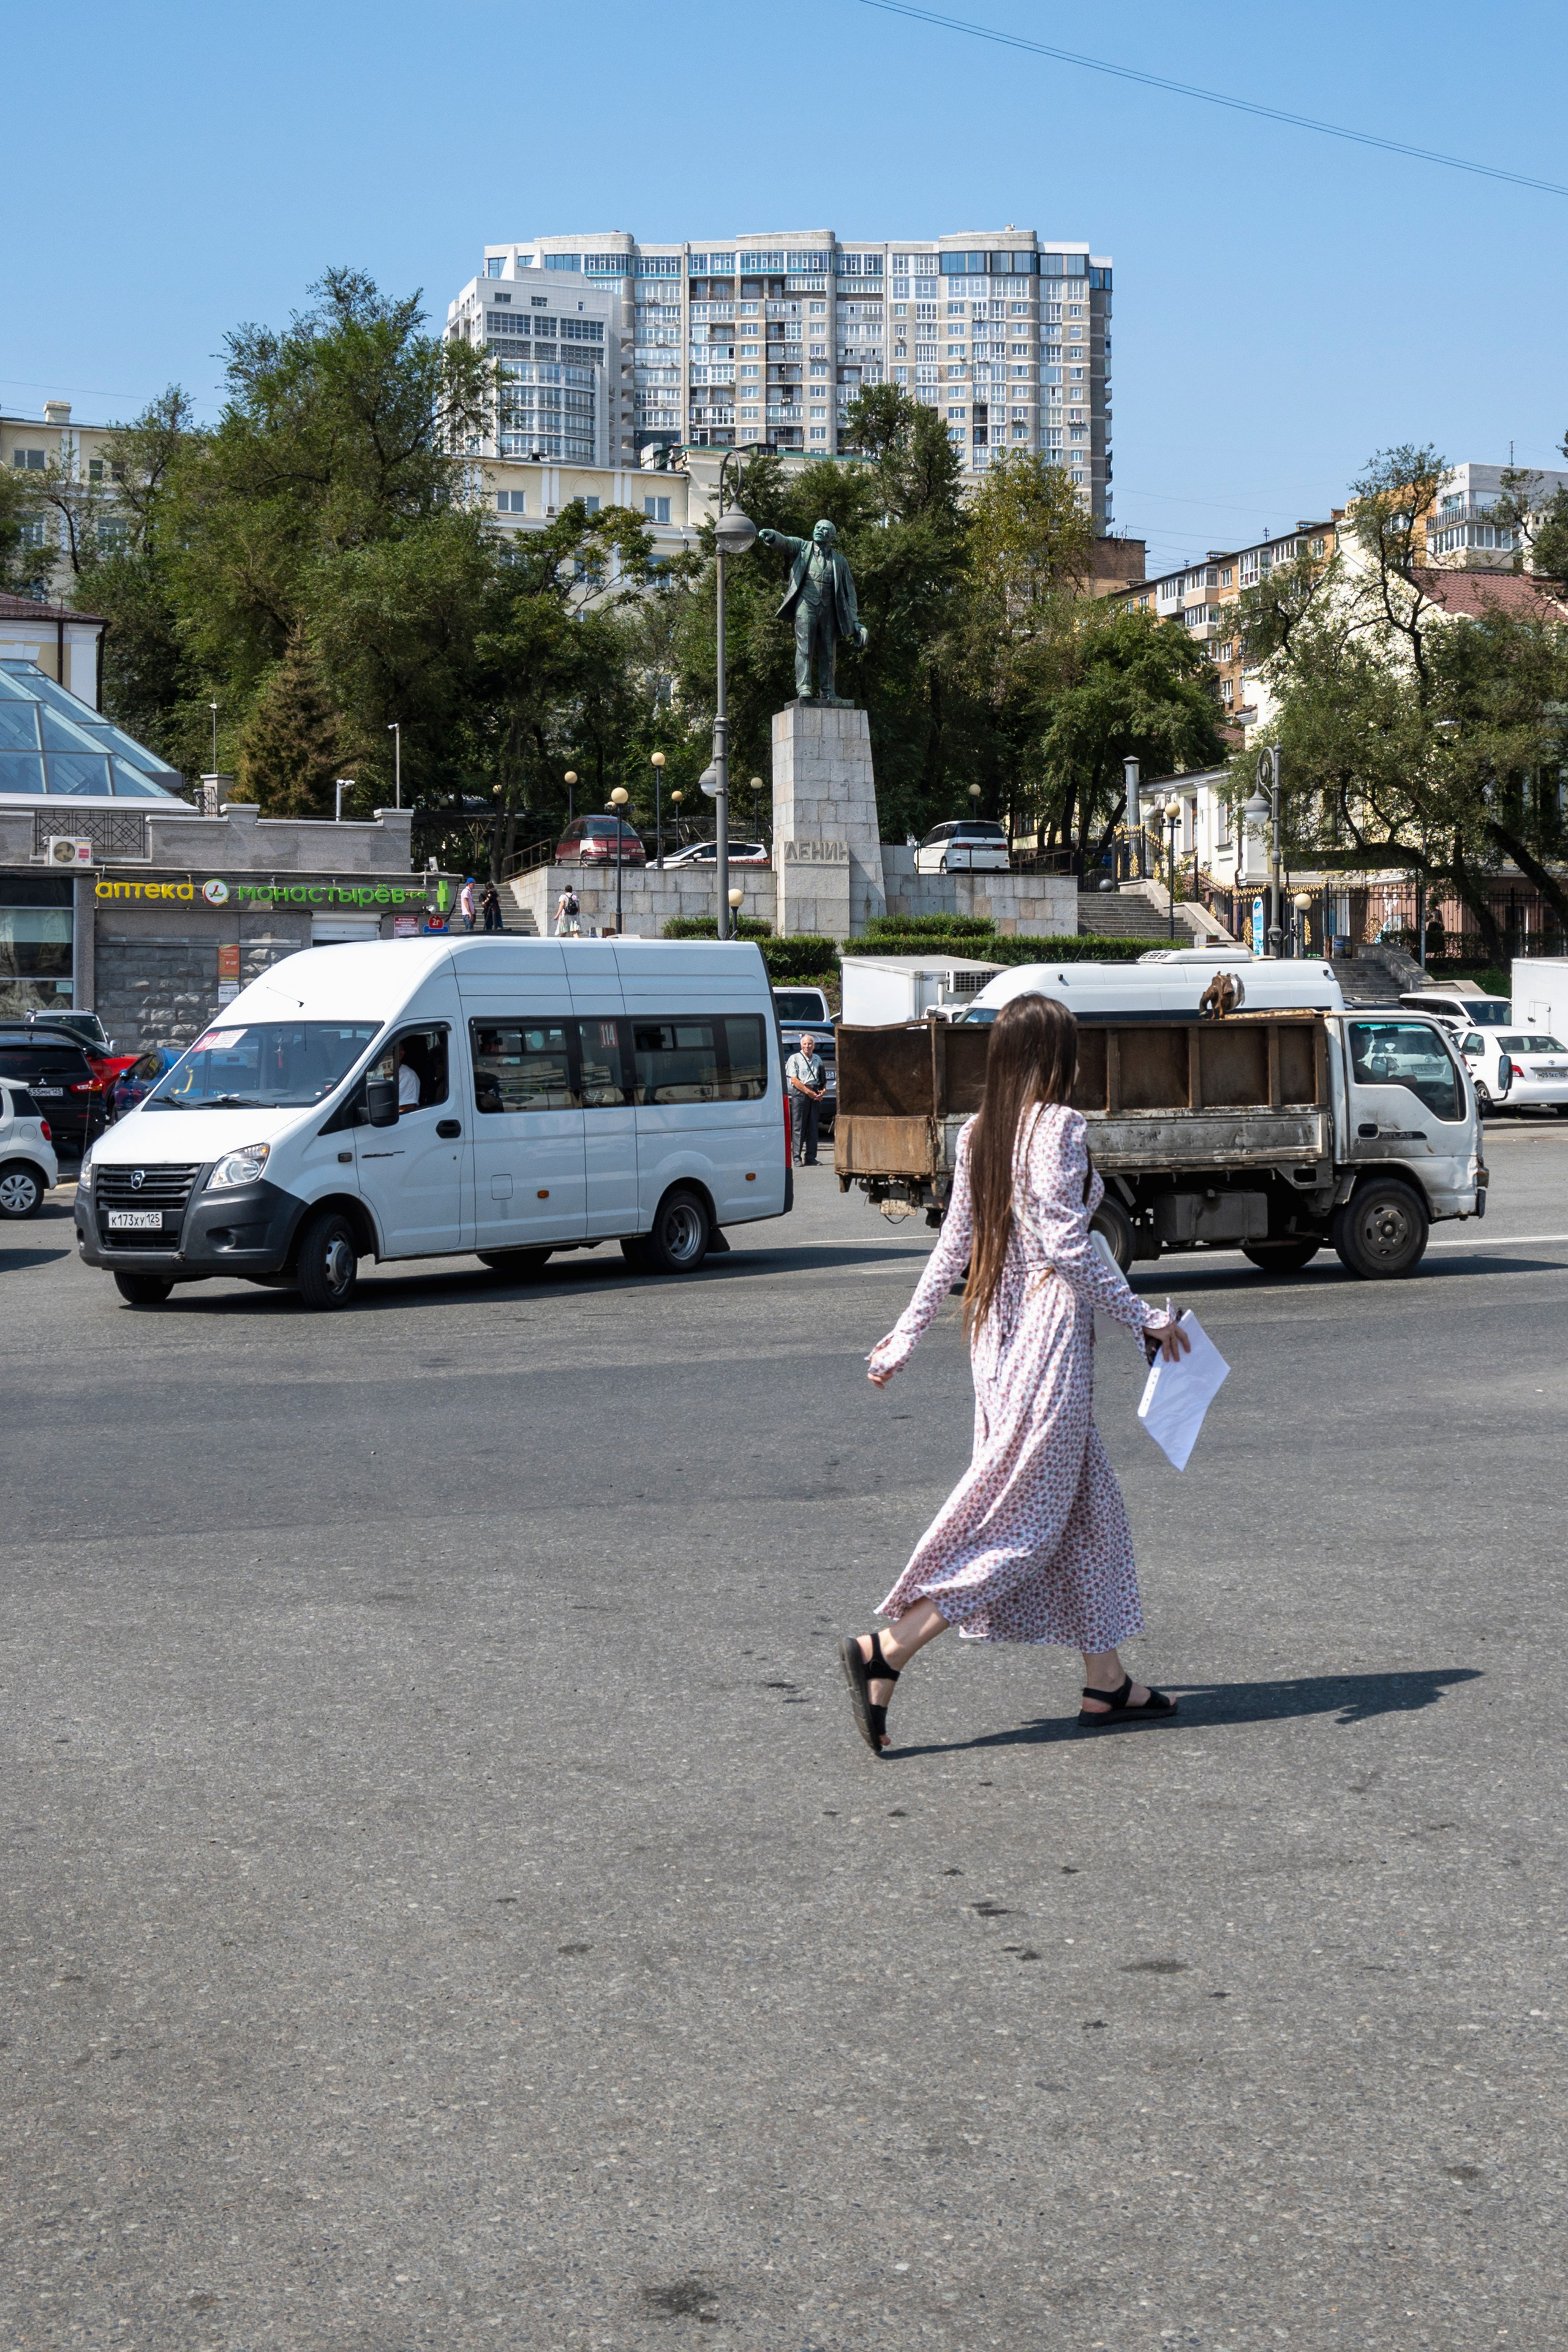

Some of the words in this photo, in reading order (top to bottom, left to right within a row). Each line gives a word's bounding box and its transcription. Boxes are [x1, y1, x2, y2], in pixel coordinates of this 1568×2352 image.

[784, 842, 849, 861] ЛЕНИН
[95, 882, 194, 900] аптека
[601, 1024, 615, 1046] 114
[111, 1214, 145, 1226] К173ХУ
[146, 1213, 160, 1223] 125
